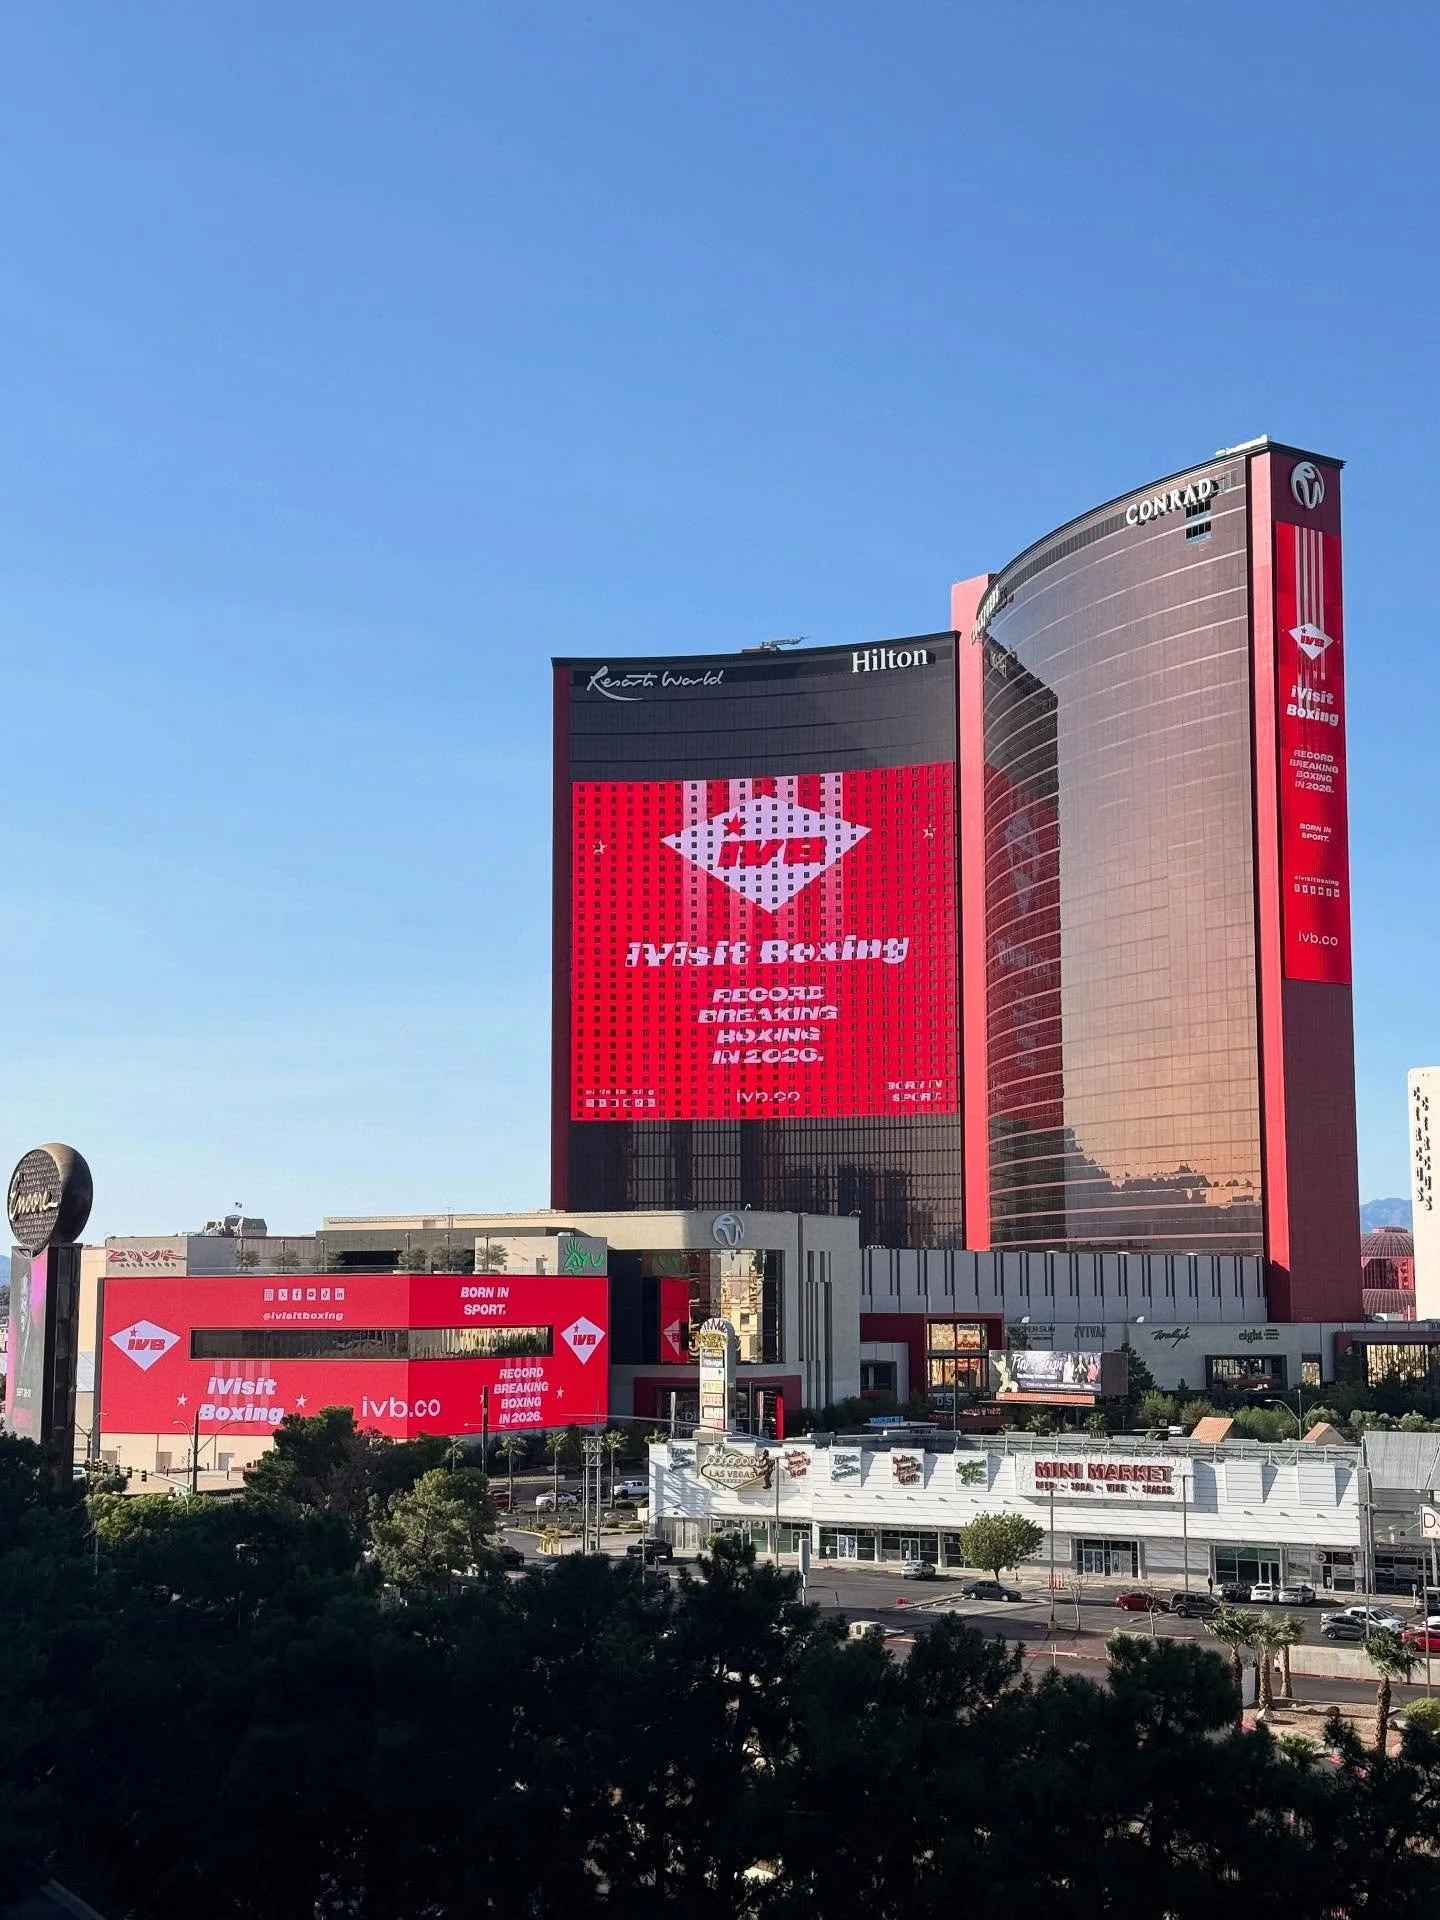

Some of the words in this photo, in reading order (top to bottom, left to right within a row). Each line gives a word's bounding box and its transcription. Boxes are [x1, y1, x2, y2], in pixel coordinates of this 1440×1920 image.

[1125, 477, 1211, 525] CONRAD
[852, 647, 928, 673] Hilton
[662, 669, 725, 688] World
[1290, 684, 1334, 706] iVisit
[1286, 703, 1339, 727] Boxing
[1293, 749, 1334, 763] RECORD
[1289, 758, 1339, 774] BREAKING
[1296, 769, 1333, 783] BOXING
[1295, 780, 1305, 789] IN
[1299, 822, 1322, 832] BORN
[1323, 826, 1332, 834] IN
[1298, 930, 1339, 946] ivb.co
[625, 939, 751, 967] iVisit
[759, 934, 910, 964] Boxing
[713, 985, 825, 1003] RECORD
[698, 1005, 839, 1024] BREAKING
[717, 1026, 821, 1044] BOXING
[712, 1049, 740, 1065] IN
[460, 1286, 494, 1298] BORN
[496, 1286, 510, 1298] IN
[263, 1312, 344, 1321] @ivisitboxing
[463, 1303, 506, 1316] SPORT.
[499, 1367, 544, 1379] RECORD
[207, 1377, 278, 1396] iVisit
[493, 1381, 549, 1395] BREAKING
[362, 1396, 441, 1418] ivb.co
[500, 1397, 542, 1409] BOXING
[199, 1403, 284, 1425] Boxing
[499, 1412, 510, 1424] IN
[708, 1470, 726, 1478] LAS
[727, 1471, 757, 1479] VEGAS
[1035, 1461, 1083, 1479] MINI
[1087, 1463, 1174, 1482] MARKET
